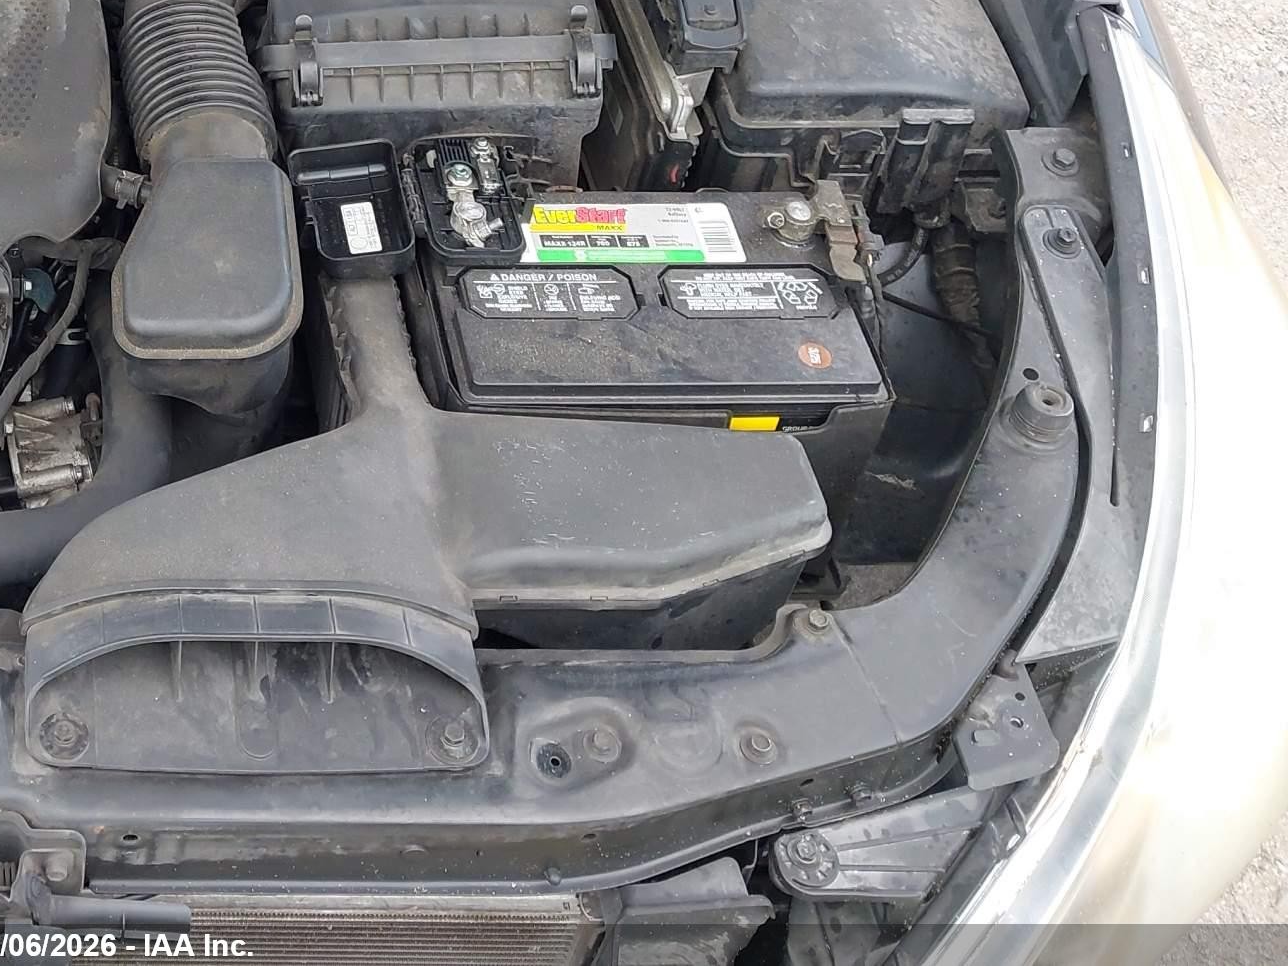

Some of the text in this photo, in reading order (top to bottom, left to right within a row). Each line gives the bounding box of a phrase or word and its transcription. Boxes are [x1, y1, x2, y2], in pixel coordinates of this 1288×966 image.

[533, 206, 626, 224] EverStart
[500, 273, 545, 282] DANGER
[556, 273, 598, 282] POISON
